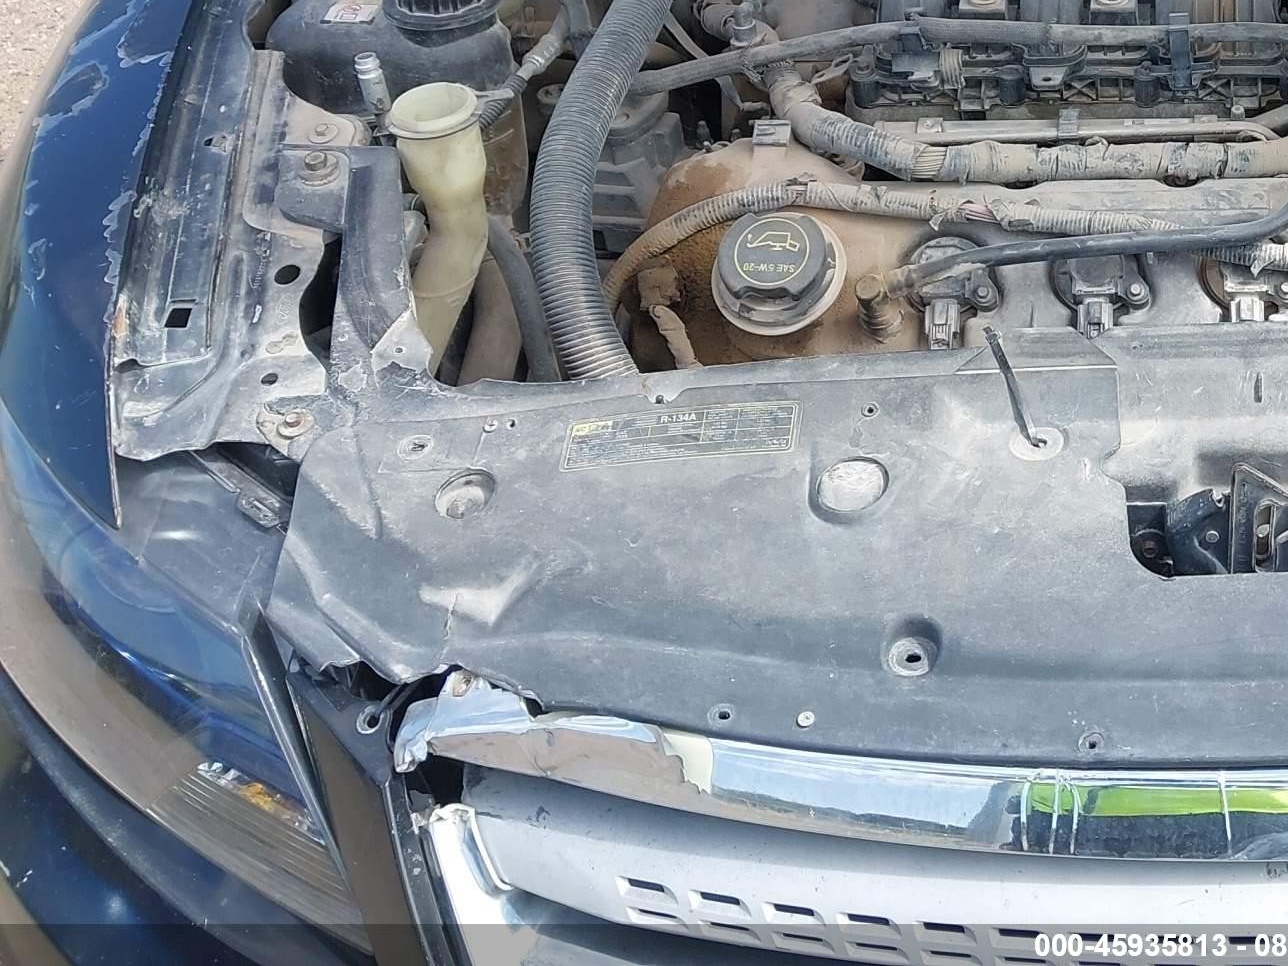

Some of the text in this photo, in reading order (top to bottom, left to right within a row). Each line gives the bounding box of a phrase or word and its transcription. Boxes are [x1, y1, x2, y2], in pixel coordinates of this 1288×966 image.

[743, 262, 796, 273] SAE 5W-20
[660, 412, 697, 424] R-134A
